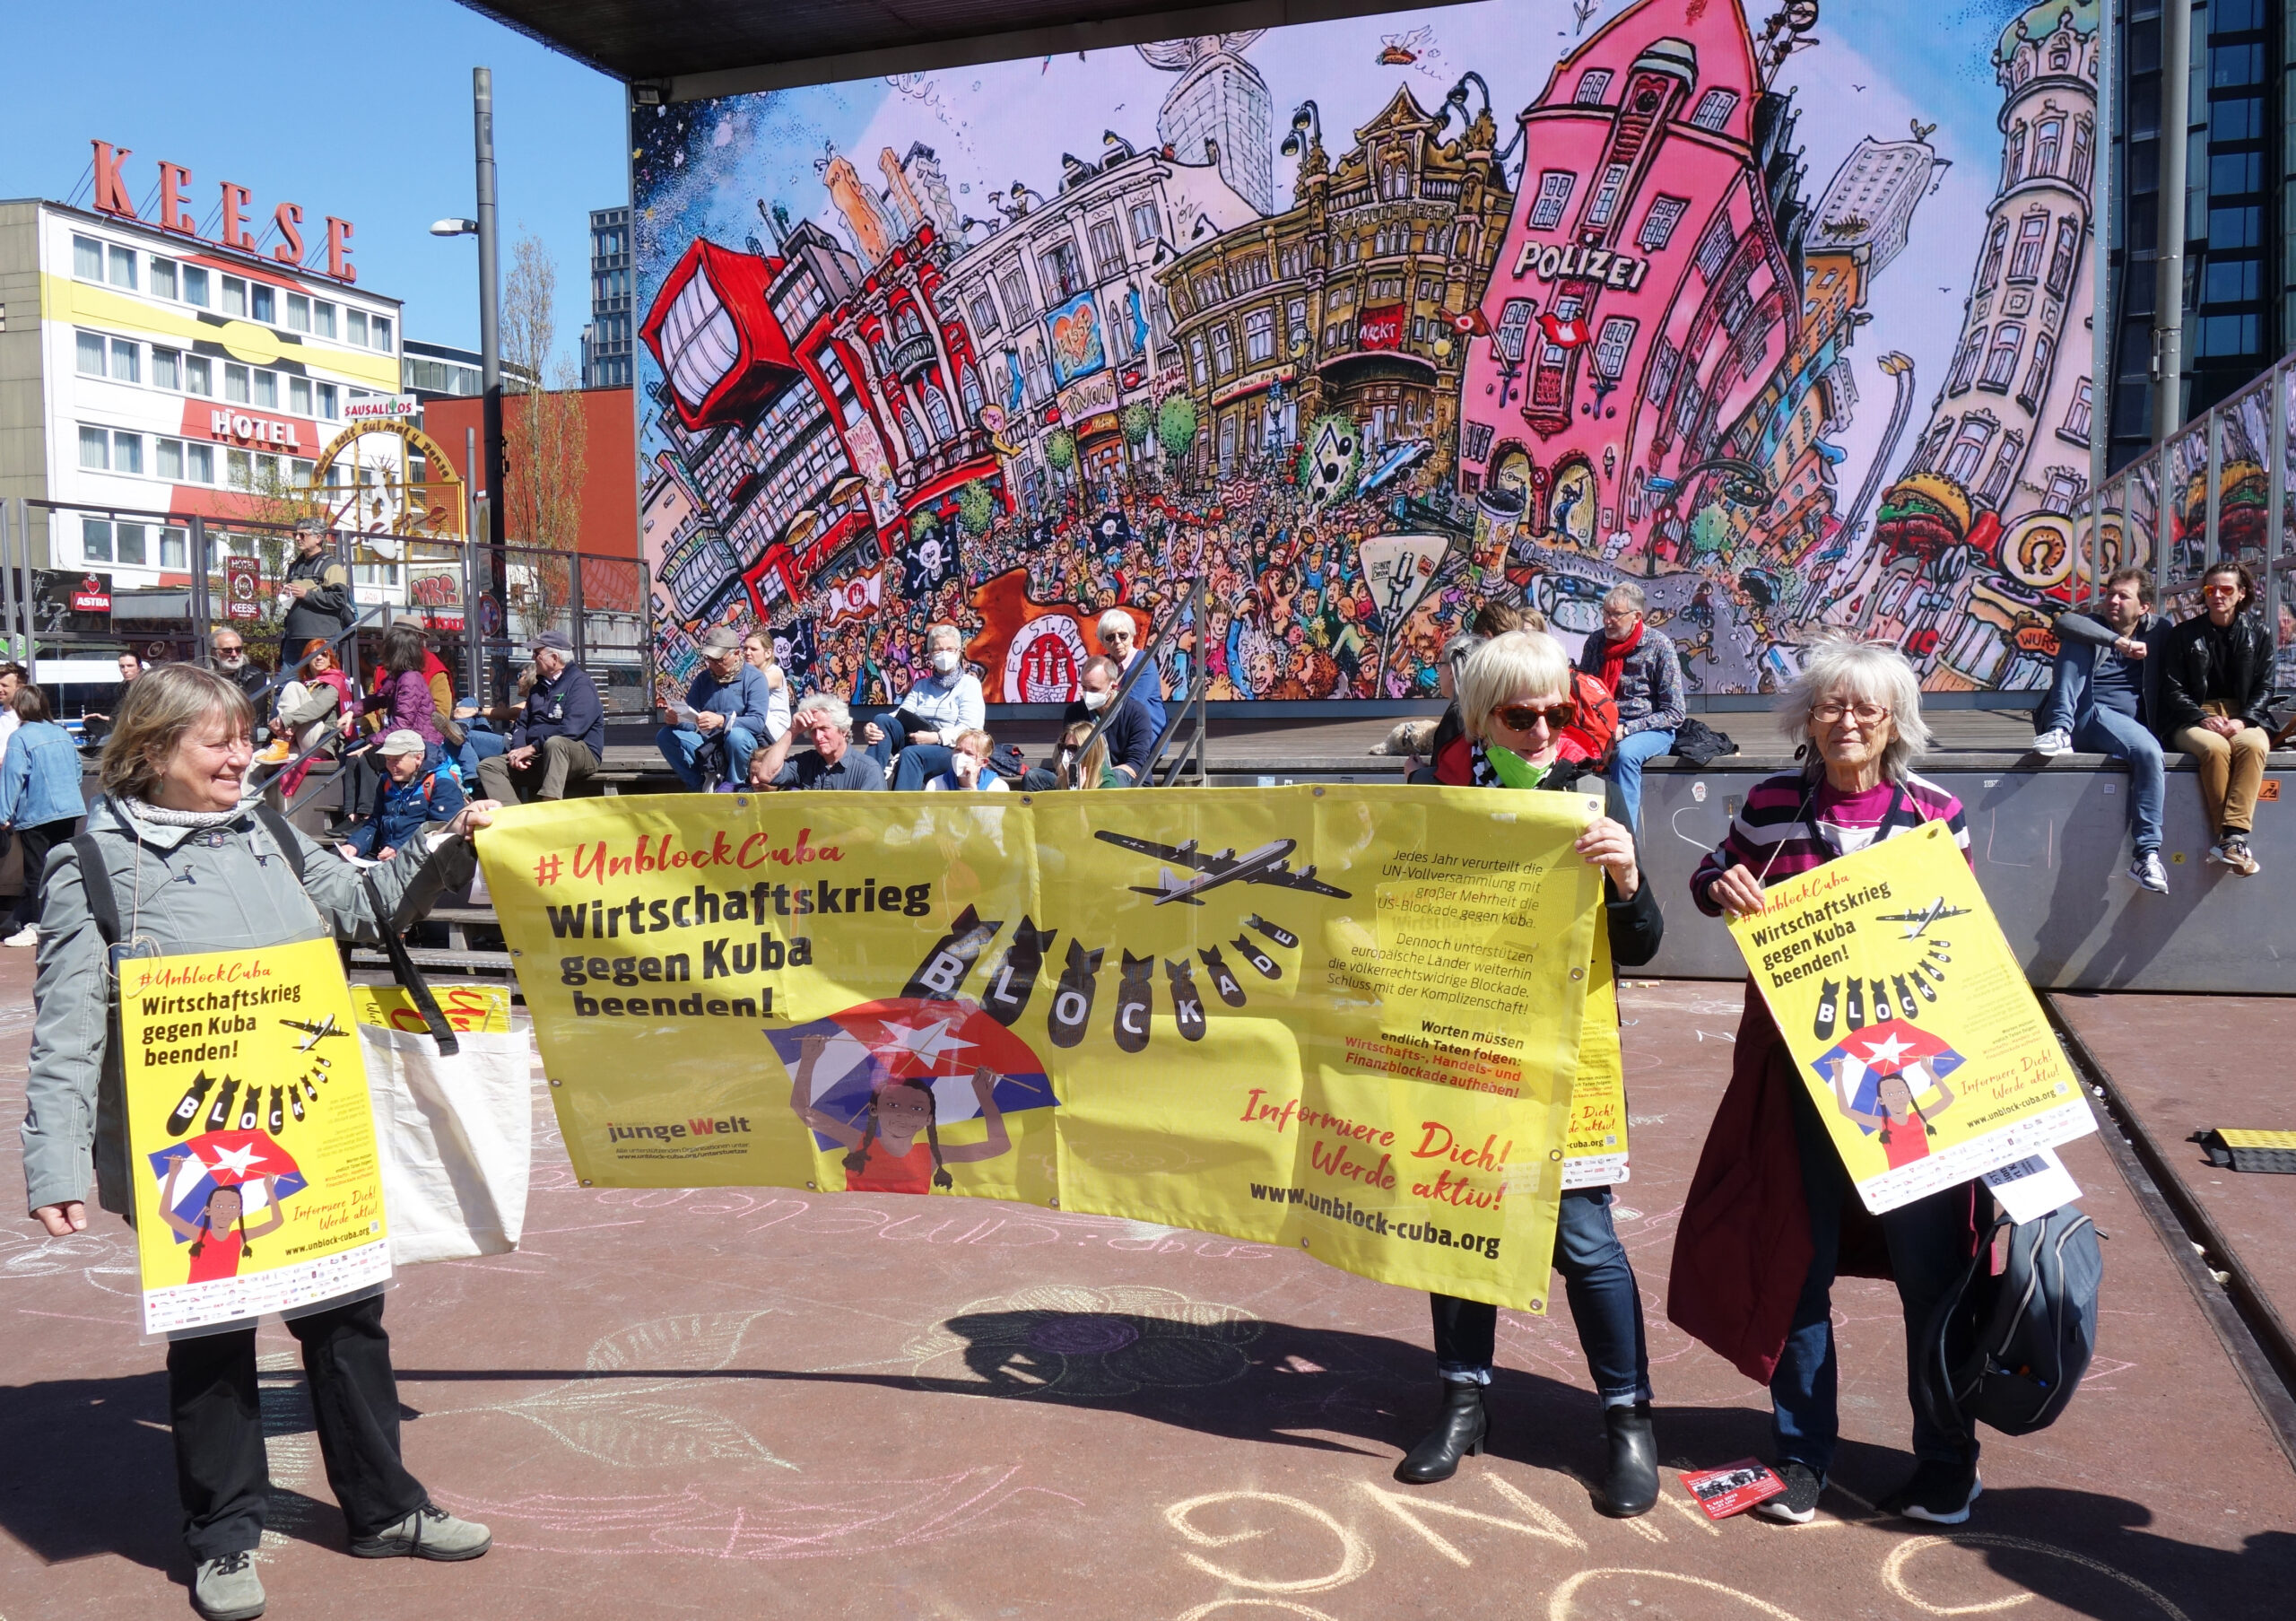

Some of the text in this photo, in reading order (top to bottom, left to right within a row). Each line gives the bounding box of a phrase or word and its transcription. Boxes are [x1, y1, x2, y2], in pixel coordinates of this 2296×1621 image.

[91, 139, 356, 284] KEESE
[1512, 240, 1649, 292] POLIZEI
[211, 409, 301, 448] HOTEL
[231, 559, 257, 570] HOTEL
[76, 597, 109, 607] ASTRA
[231, 603, 257, 614] KEESE
[533, 828, 845, 886] #UnblockCuba
[1392, 850, 1544, 876] Jedes Jahr verurteilt die
[1382, 864, 1541, 894] UN-Vollversammlung mit
[546, 878, 931, 938] Wirtschaftskrieg
[1378, 897, 1458, 918] US-Blockade
[1459, 908, 1499, 924] gegen
[1501, 911, 1536, 929] Kuba.
[1415, 886, 1540, 911] großer Mehrheit die
[1751, 882, 1892, 948] Wirtschaftskrieg
[560, 931, 813, 987] gegen Kuba
[1352, 946, 1532, 980] europäische Länder weiterhin
[1396, 932, 1534, 963] Dennoch unterstützen
[1762, 919, 1857, 971] gegen Kuba
[139, 960, 272, 988] #UnblockCuba
[919, 929, 1292, 1034] BLOCKADE
[1328, 957, 1530, 998] die völkerrechtswidrige Blockade.
[1770, 944, 1850, 989] beenden!
[1818, 941, 1948, 1023] BLOCKADE
[142, 984, 301, 1015] Wirtschaftskrieg
[573, 987, 774, 1018] beenden!
[1326, 972, 1528, 1015] Schluss mit der Komplizenschaft!
[142, 1015, 257, 1044] gegen Kuba
[1422, 1020, 1524, 1050] Worten müssen
[144, 1041, 239, 1067] beenden!
[1345, 1036, 1521, 1083] Wirtschafts-, Handels- und
[1381, 1032, 1522, 1068] endlich Taten folgen:
[1345, 1051, 1519, 1099] Finanzblockade aufheben!
[1961, 1049, 2053, 1095] Informiere Dich!
[1992, 1064, 2059, 1100] Werde aktiv!
[176, 1059, 331, 1129] BLOCKADE
[1967, 1088, 2057, 1129] www.unblock-cuba.org
[606, 1116, 752, 1143] junge Welt
[1239, 1088, 1396, 1146] Informiere
[1410, 1121, 1513, 1172] Dich!
[1583, 1105, 1613, 1120] Dich!
[1311, 1140, 1509, 1212] Werde aktiv!
[293, 1185, 376, 1221] Informiere Dich!
[319, 1201, 378, 1230] Werde aktiv!
[1250, 1182, 1501, 1260] www.unblock-cuba.org
[285, 1226, 370, 1256] www.unblock-cuba.org
